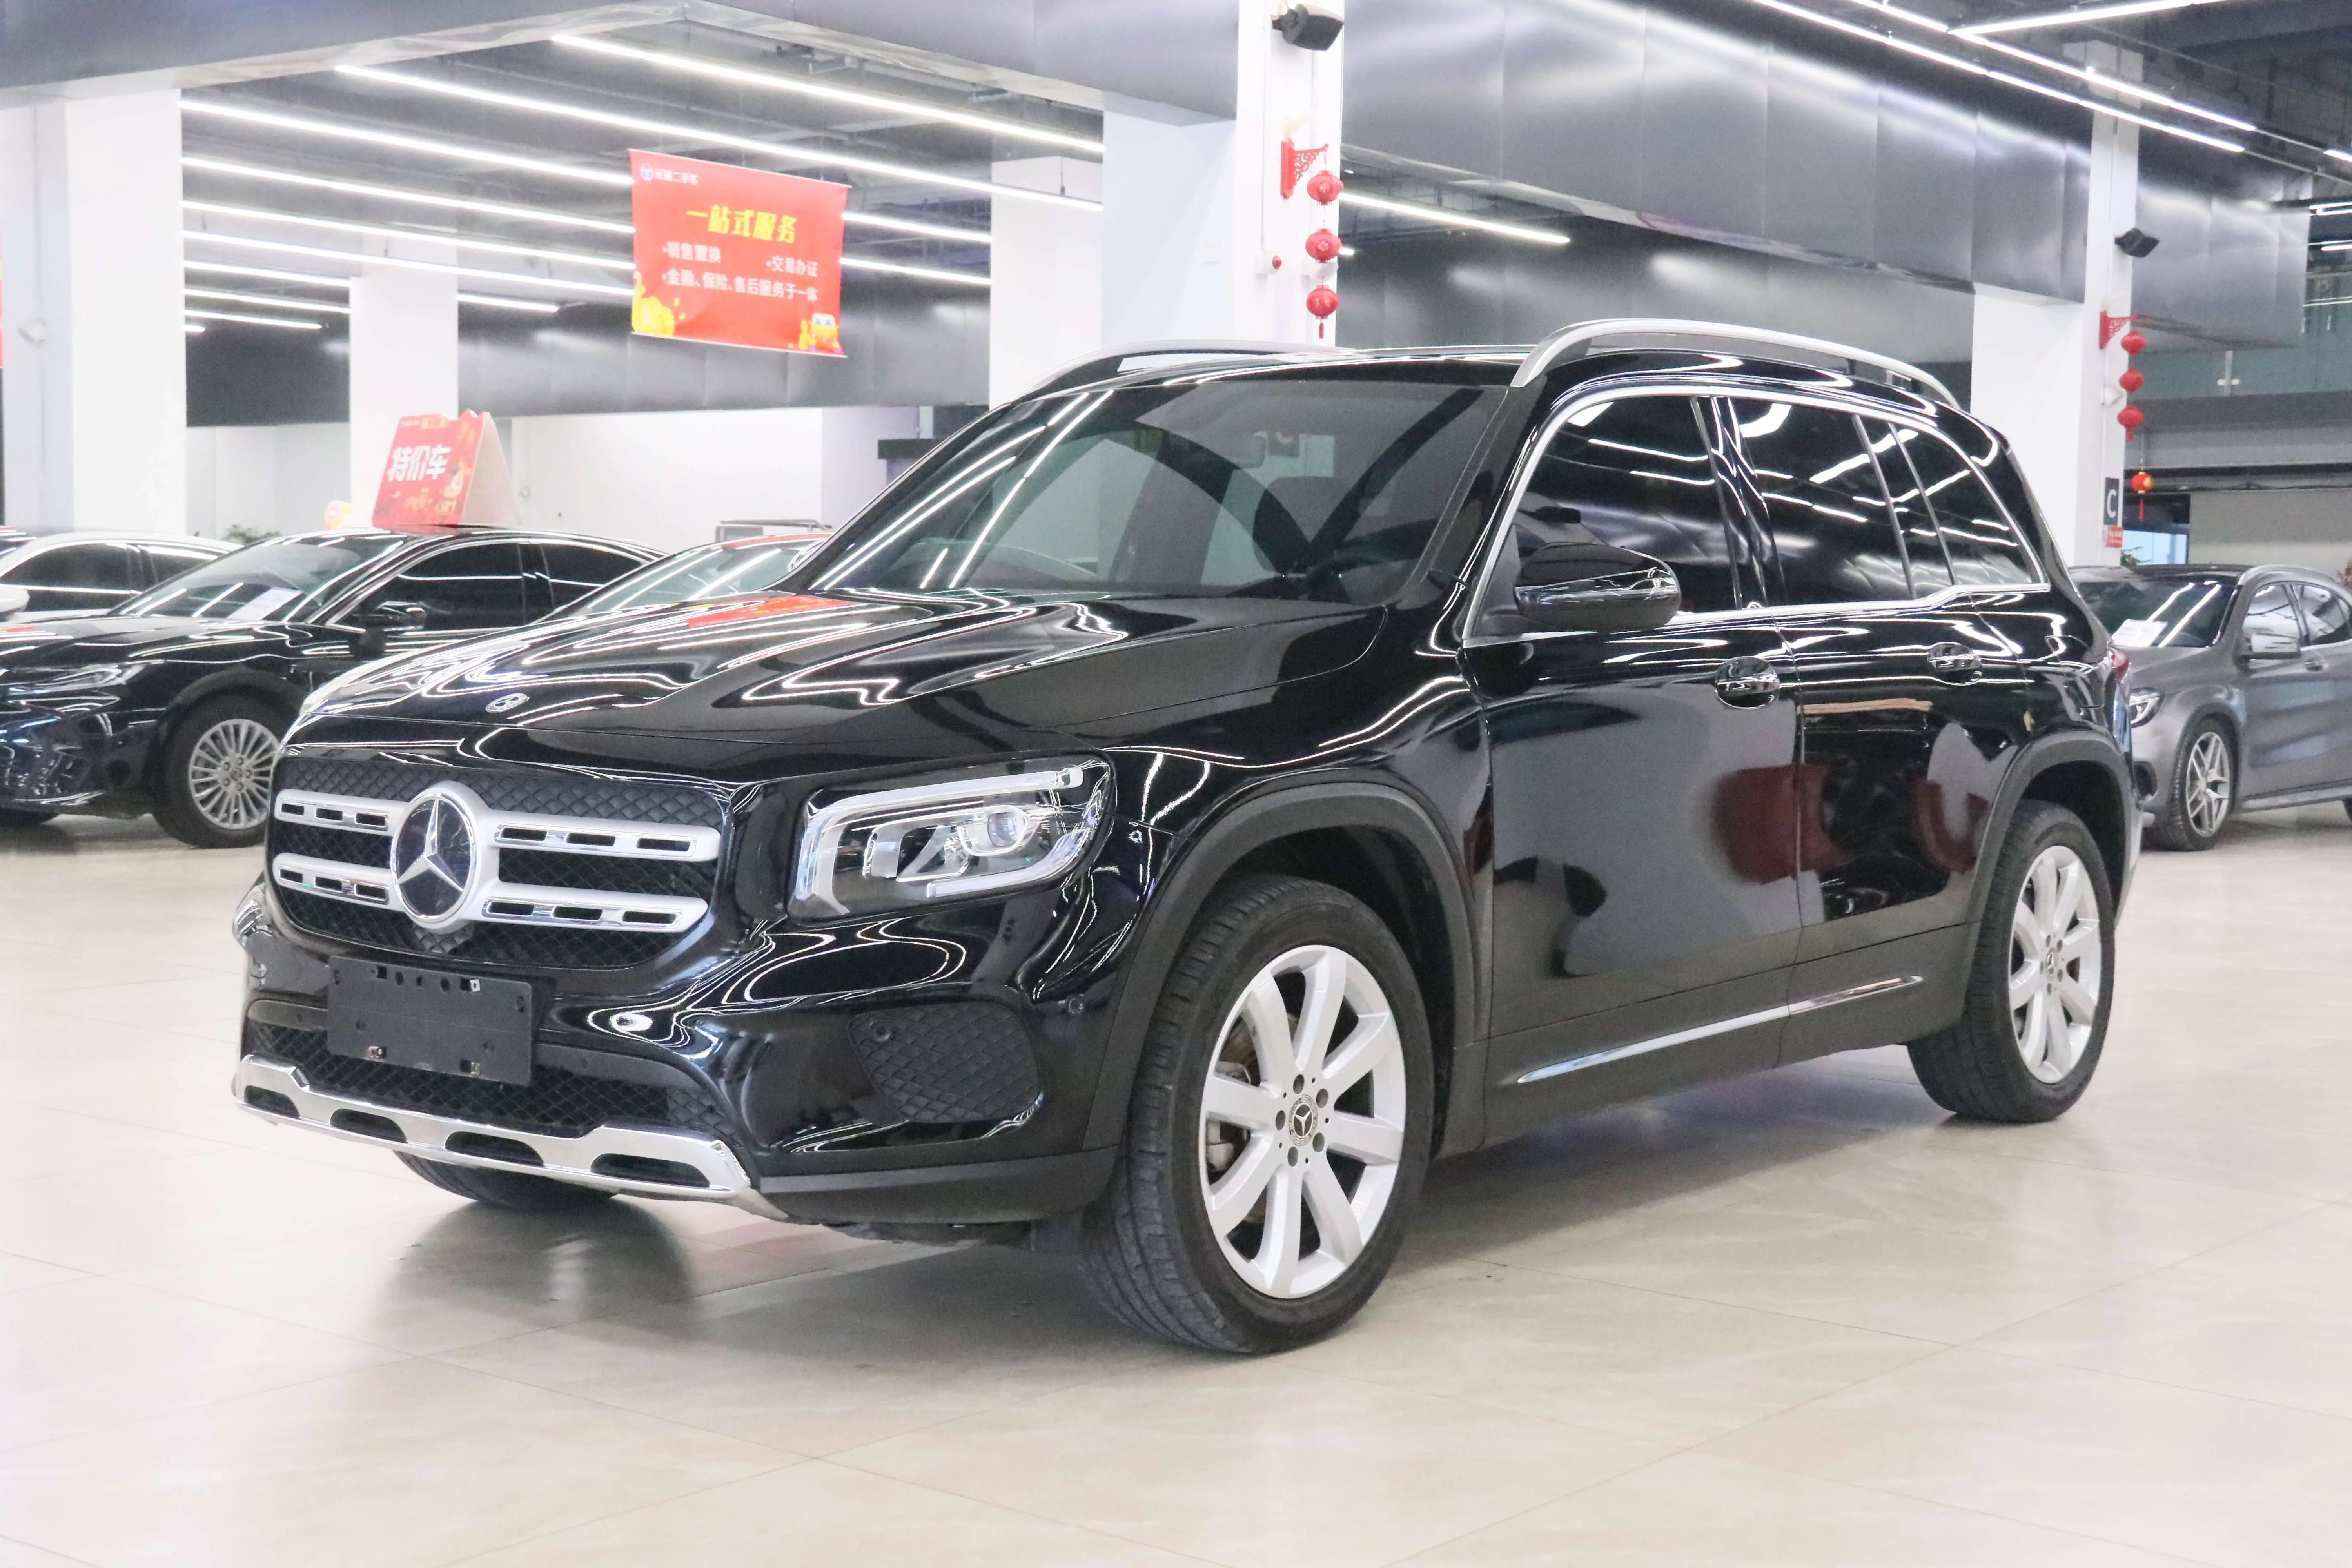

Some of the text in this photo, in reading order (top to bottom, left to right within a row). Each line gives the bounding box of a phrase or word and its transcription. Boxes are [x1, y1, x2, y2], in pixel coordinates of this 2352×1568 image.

[655, 168, 699, 185] 元二手车
[686, 204, 797, 244] 一站式服务
[667, 241, 721, 263] 销售置换
[771, 255, 818, 278] 交易办证
[387, 444, 451, 482] 特价车
[2107, 489, 2117, 519] C
